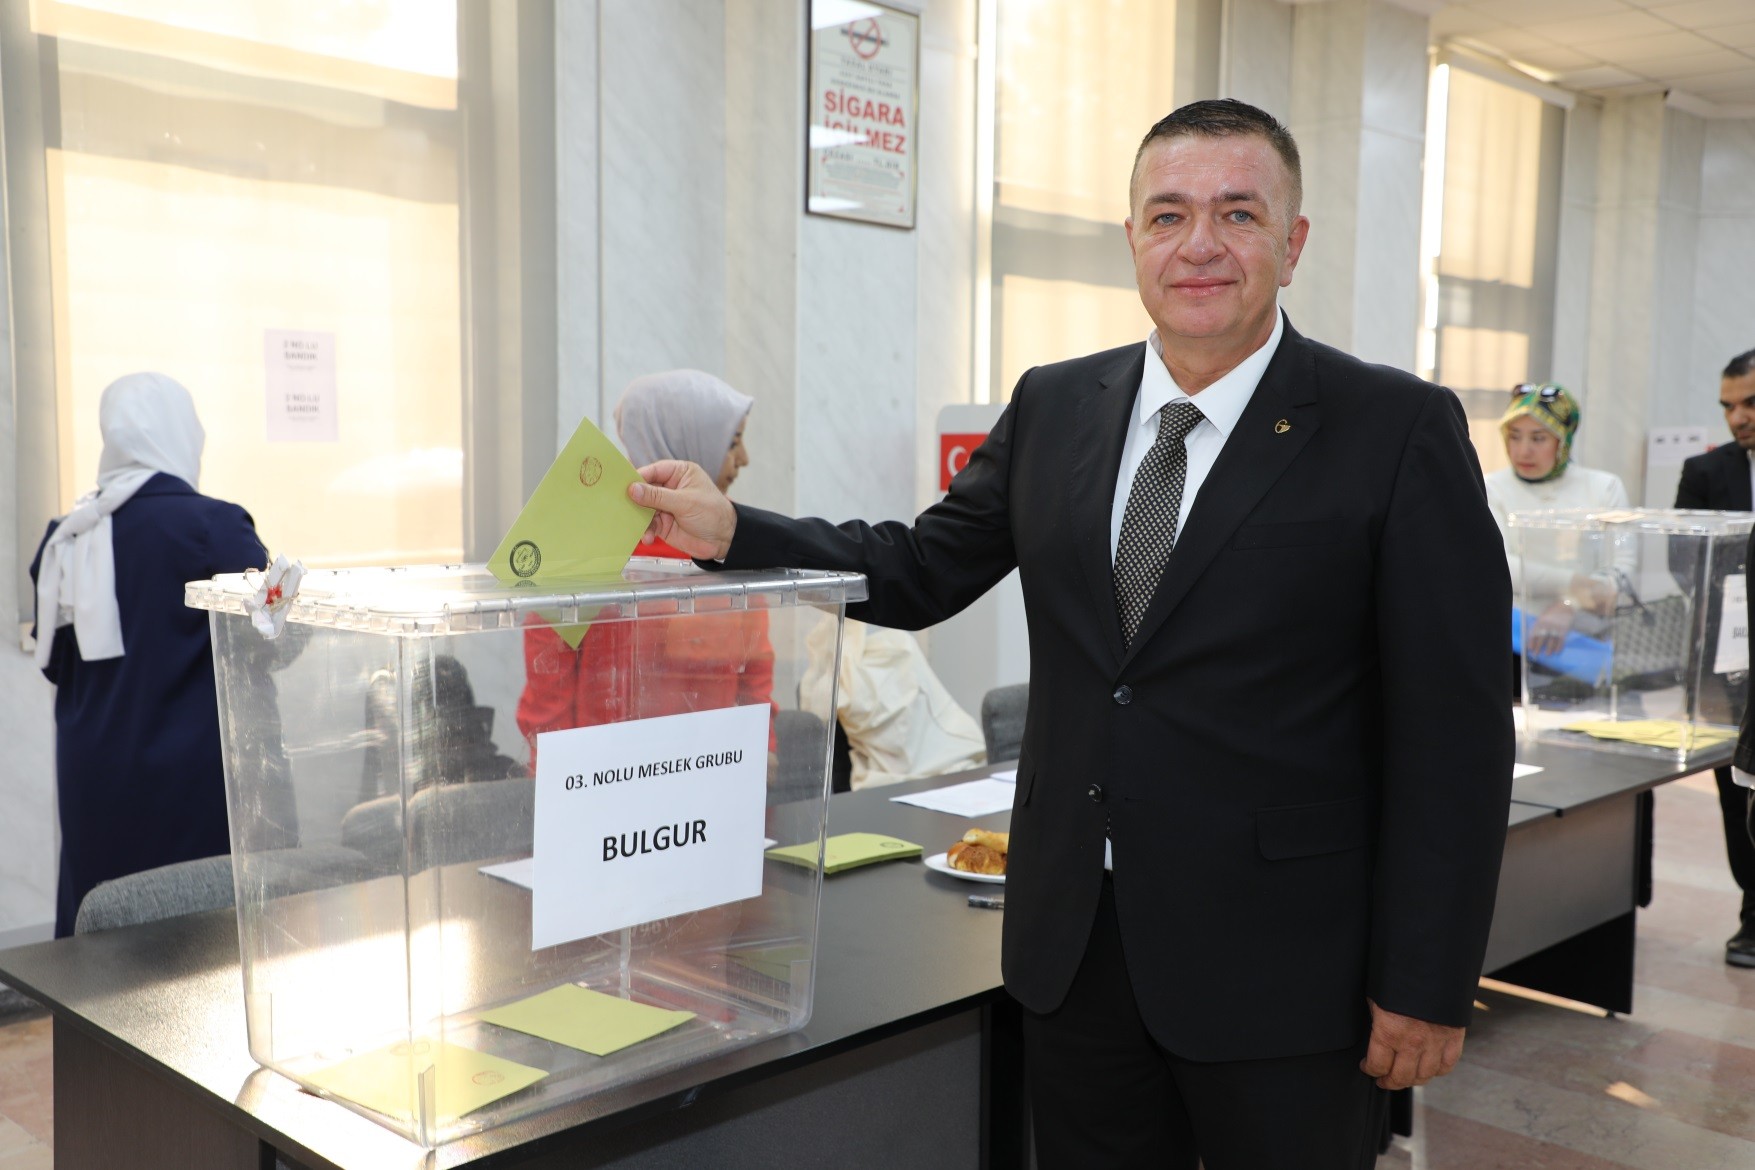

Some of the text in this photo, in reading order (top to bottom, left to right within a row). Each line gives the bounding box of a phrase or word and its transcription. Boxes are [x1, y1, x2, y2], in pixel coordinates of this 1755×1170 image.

[824, 88, 906, 127] SİGARA
[823, 115, 906, 154] LMEZ
[565, 749, 743, 790] 03. NOLU MESLEK GRUBU
[602, 819, 707, 862] BULGUR
